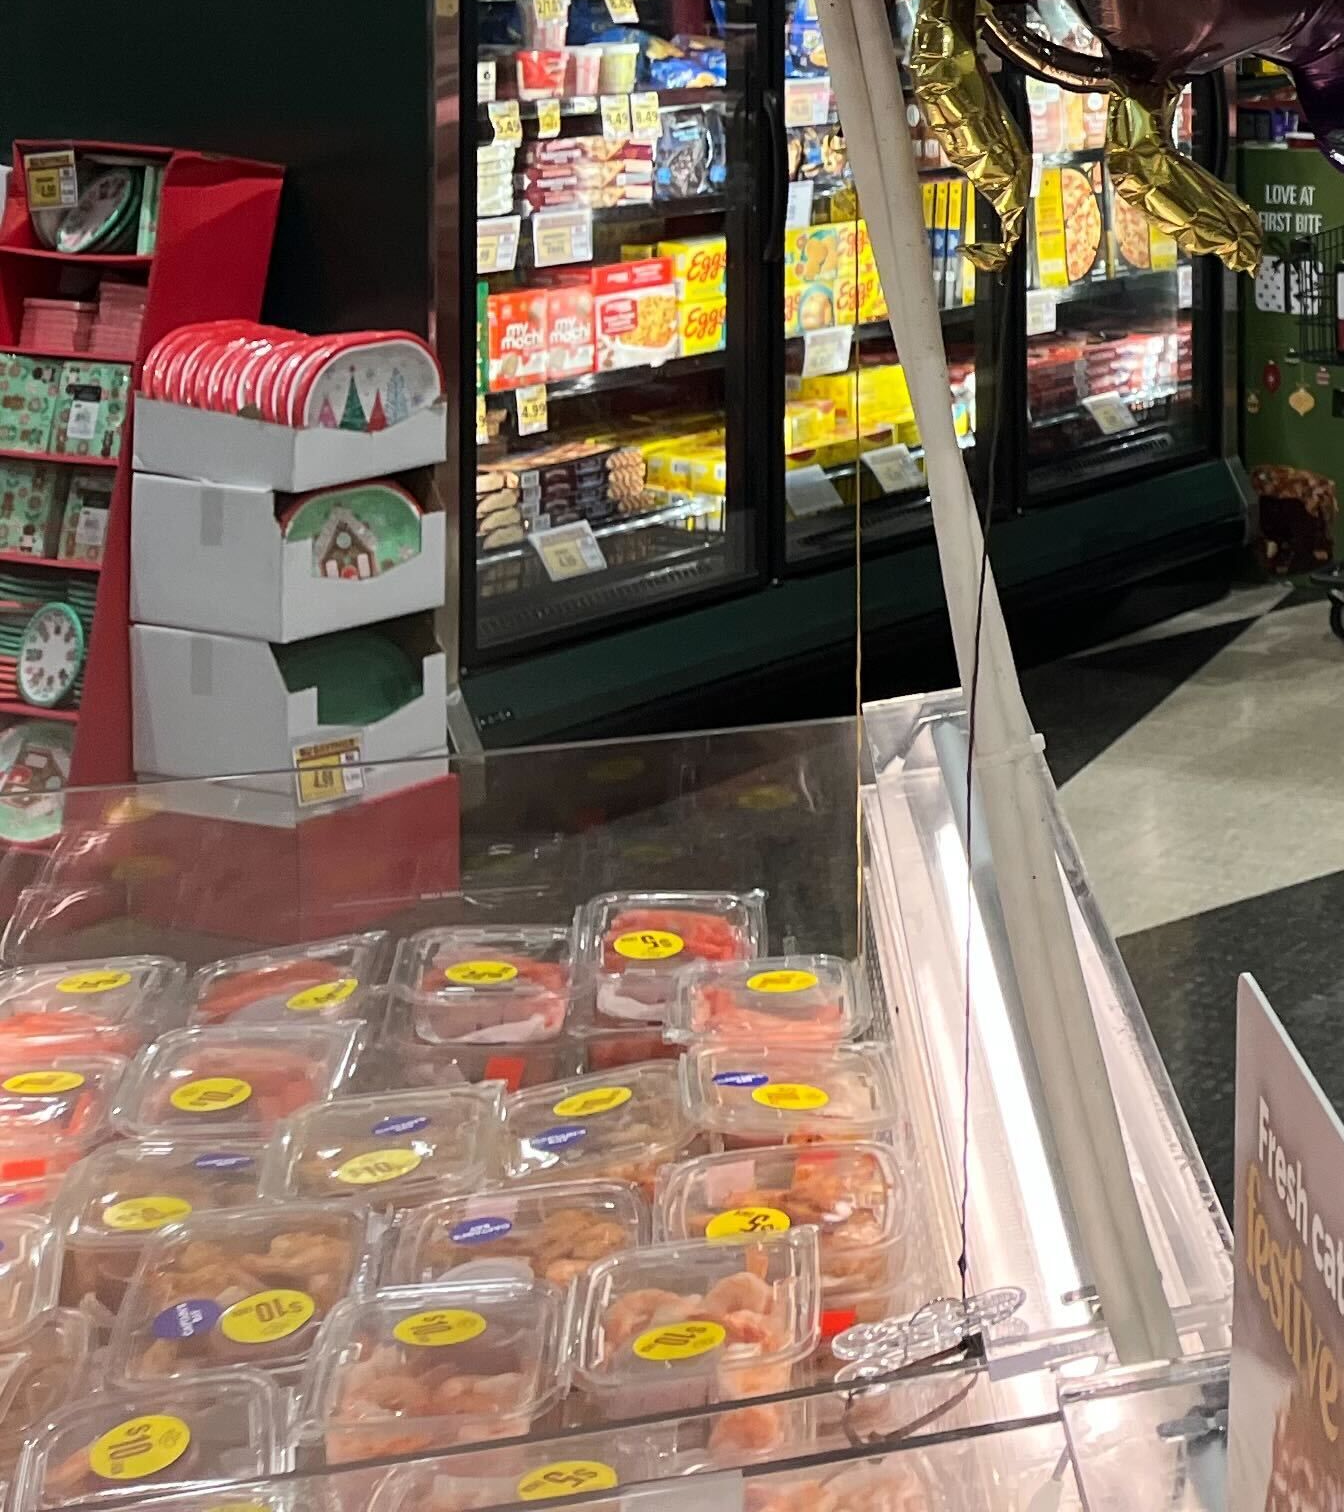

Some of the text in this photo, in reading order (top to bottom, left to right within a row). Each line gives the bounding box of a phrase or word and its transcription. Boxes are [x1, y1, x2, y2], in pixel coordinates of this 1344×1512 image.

[1264, 184, 1316, 207] LOVE AT
[1258, 1095, 1310, 1246] Fresh
[1244, 1160, 1338, 1441] festive
